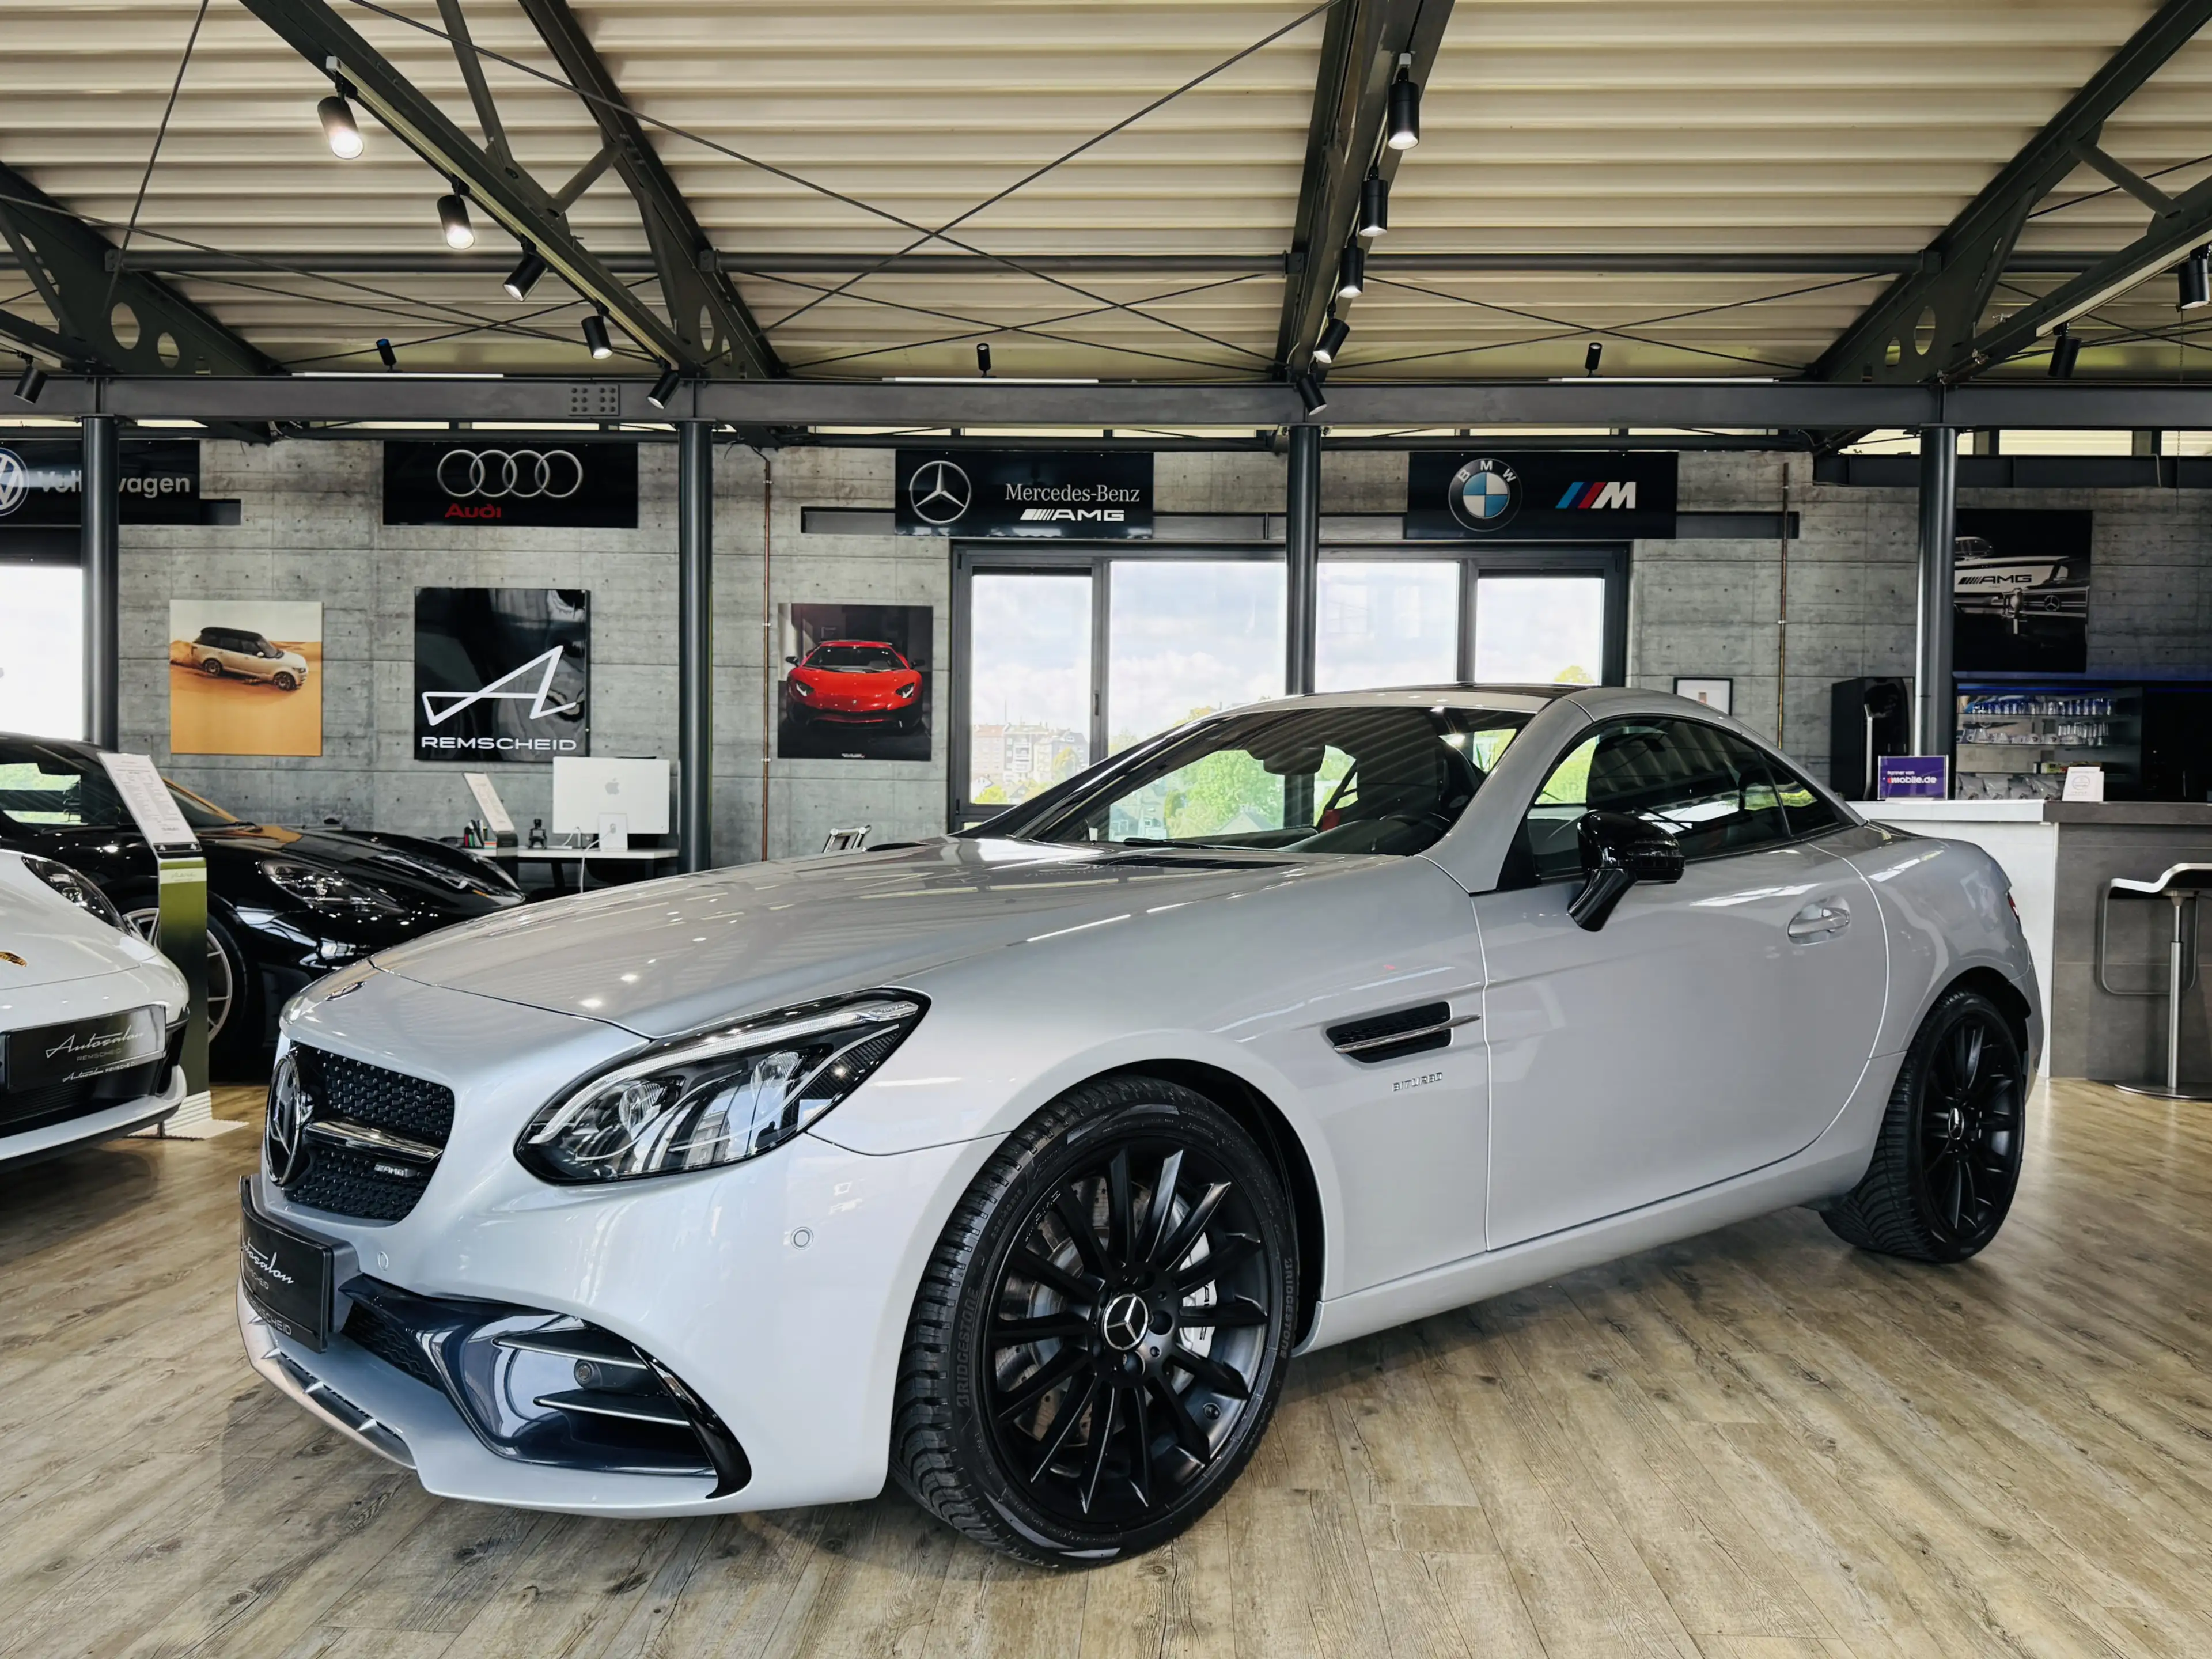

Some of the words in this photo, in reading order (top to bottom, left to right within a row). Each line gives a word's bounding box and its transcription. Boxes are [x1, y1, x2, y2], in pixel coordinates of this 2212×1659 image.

[1456, 460, 1517, 482] BMW
[1005, 483, 1141, 502] Mercedes-Benz
[444, 503, 501, 518] Audi
[1051, 509, 1124, 521] AMG
[1979, 574, 2032, 585] AMG
[421, 736, 577, 751] REMSCHEID
[1887, 775, 1937, 784] mobile.de
[45, 1024, 145, 1059] Autosalon
[62, 1067, 104, 1083] Autosalon
[1391, 1071, 1443, 1092] BITURBO
[1279, 1257, 1294, 1359] BRIDGESTONE
[956, 1286, 979, 1409] BRIDGESTONE
